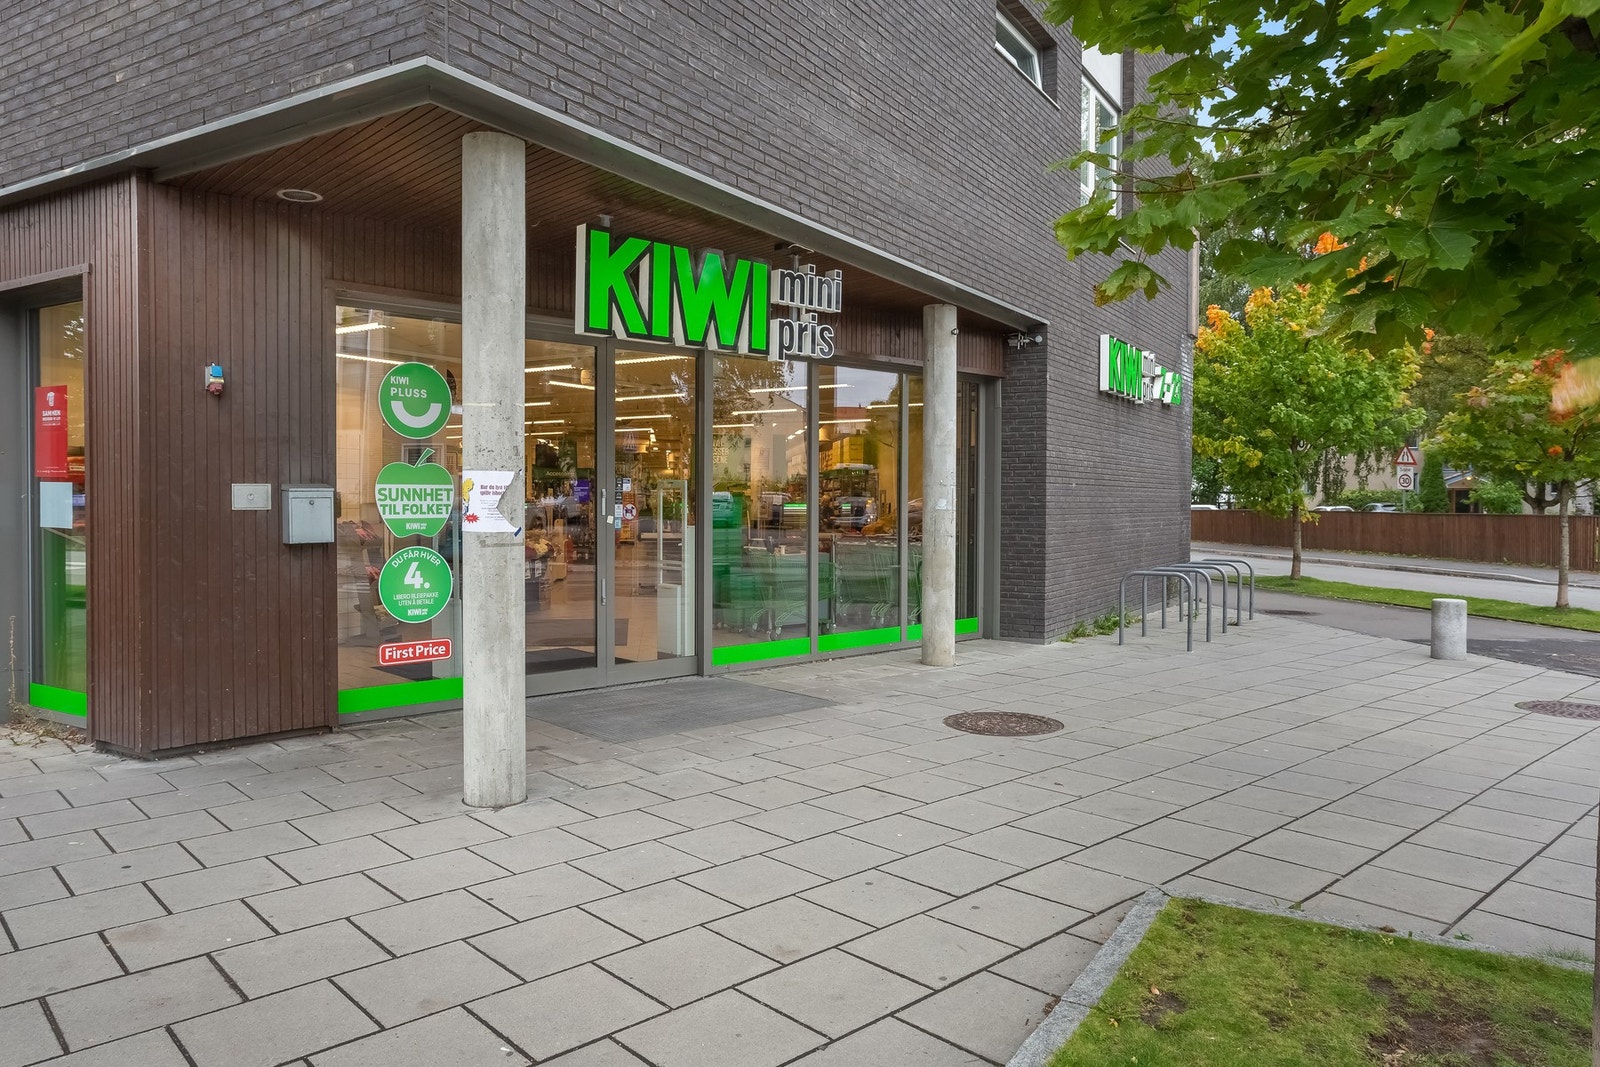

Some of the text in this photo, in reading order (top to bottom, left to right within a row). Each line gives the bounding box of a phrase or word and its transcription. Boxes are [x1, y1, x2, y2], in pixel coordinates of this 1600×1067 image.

[580, 224, 771, 355] KIWI
[777, 263, 843, 313] mini
[776, 313, 834, 362] pris
[1104, 334, 1143, 402] KIWI
[390, 376, 409, 385] KIWI
[390, 387, 427, 398] PLUSS
[1401, 477, 1410, 485] 30
[377, 487, 453, 502] SUNNHET
[380, 503, 451, 515] TIL FOLKET
[406, 522, 420, 530] KIWI
[391, 550, 441, 568] DU FÅR HVER
[404, 562, 431, 589] 4.
[398, 599, 412, 607] UTEN
[407, 608, 422, 616] KIWI
[385, 644, 446, 660] First Price
